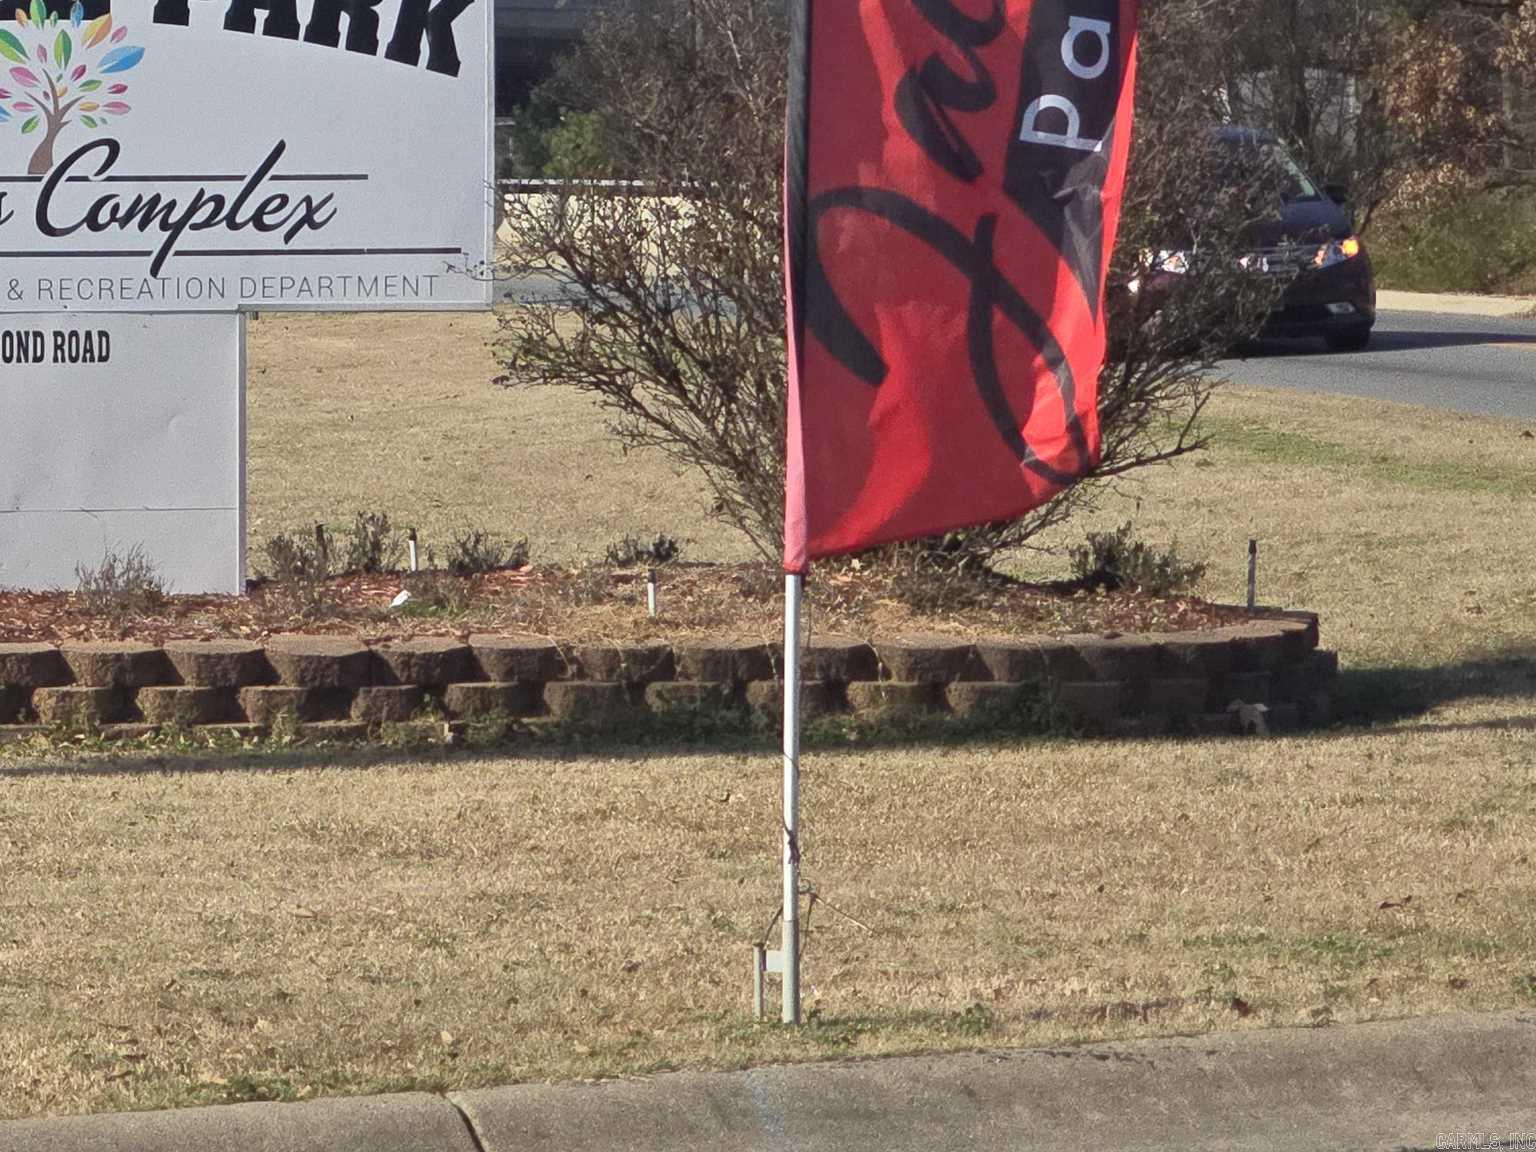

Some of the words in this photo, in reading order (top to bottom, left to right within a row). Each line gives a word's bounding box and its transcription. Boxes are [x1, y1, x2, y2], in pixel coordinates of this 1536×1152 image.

[35, 138, 337, 279] Complex
[6, 278, 25, 301] &
[37, 276, 226, 301] RECREATION
[239, 274, 440, 299] DEPARTMENT
[51, 329, 111, 364] ROAD
